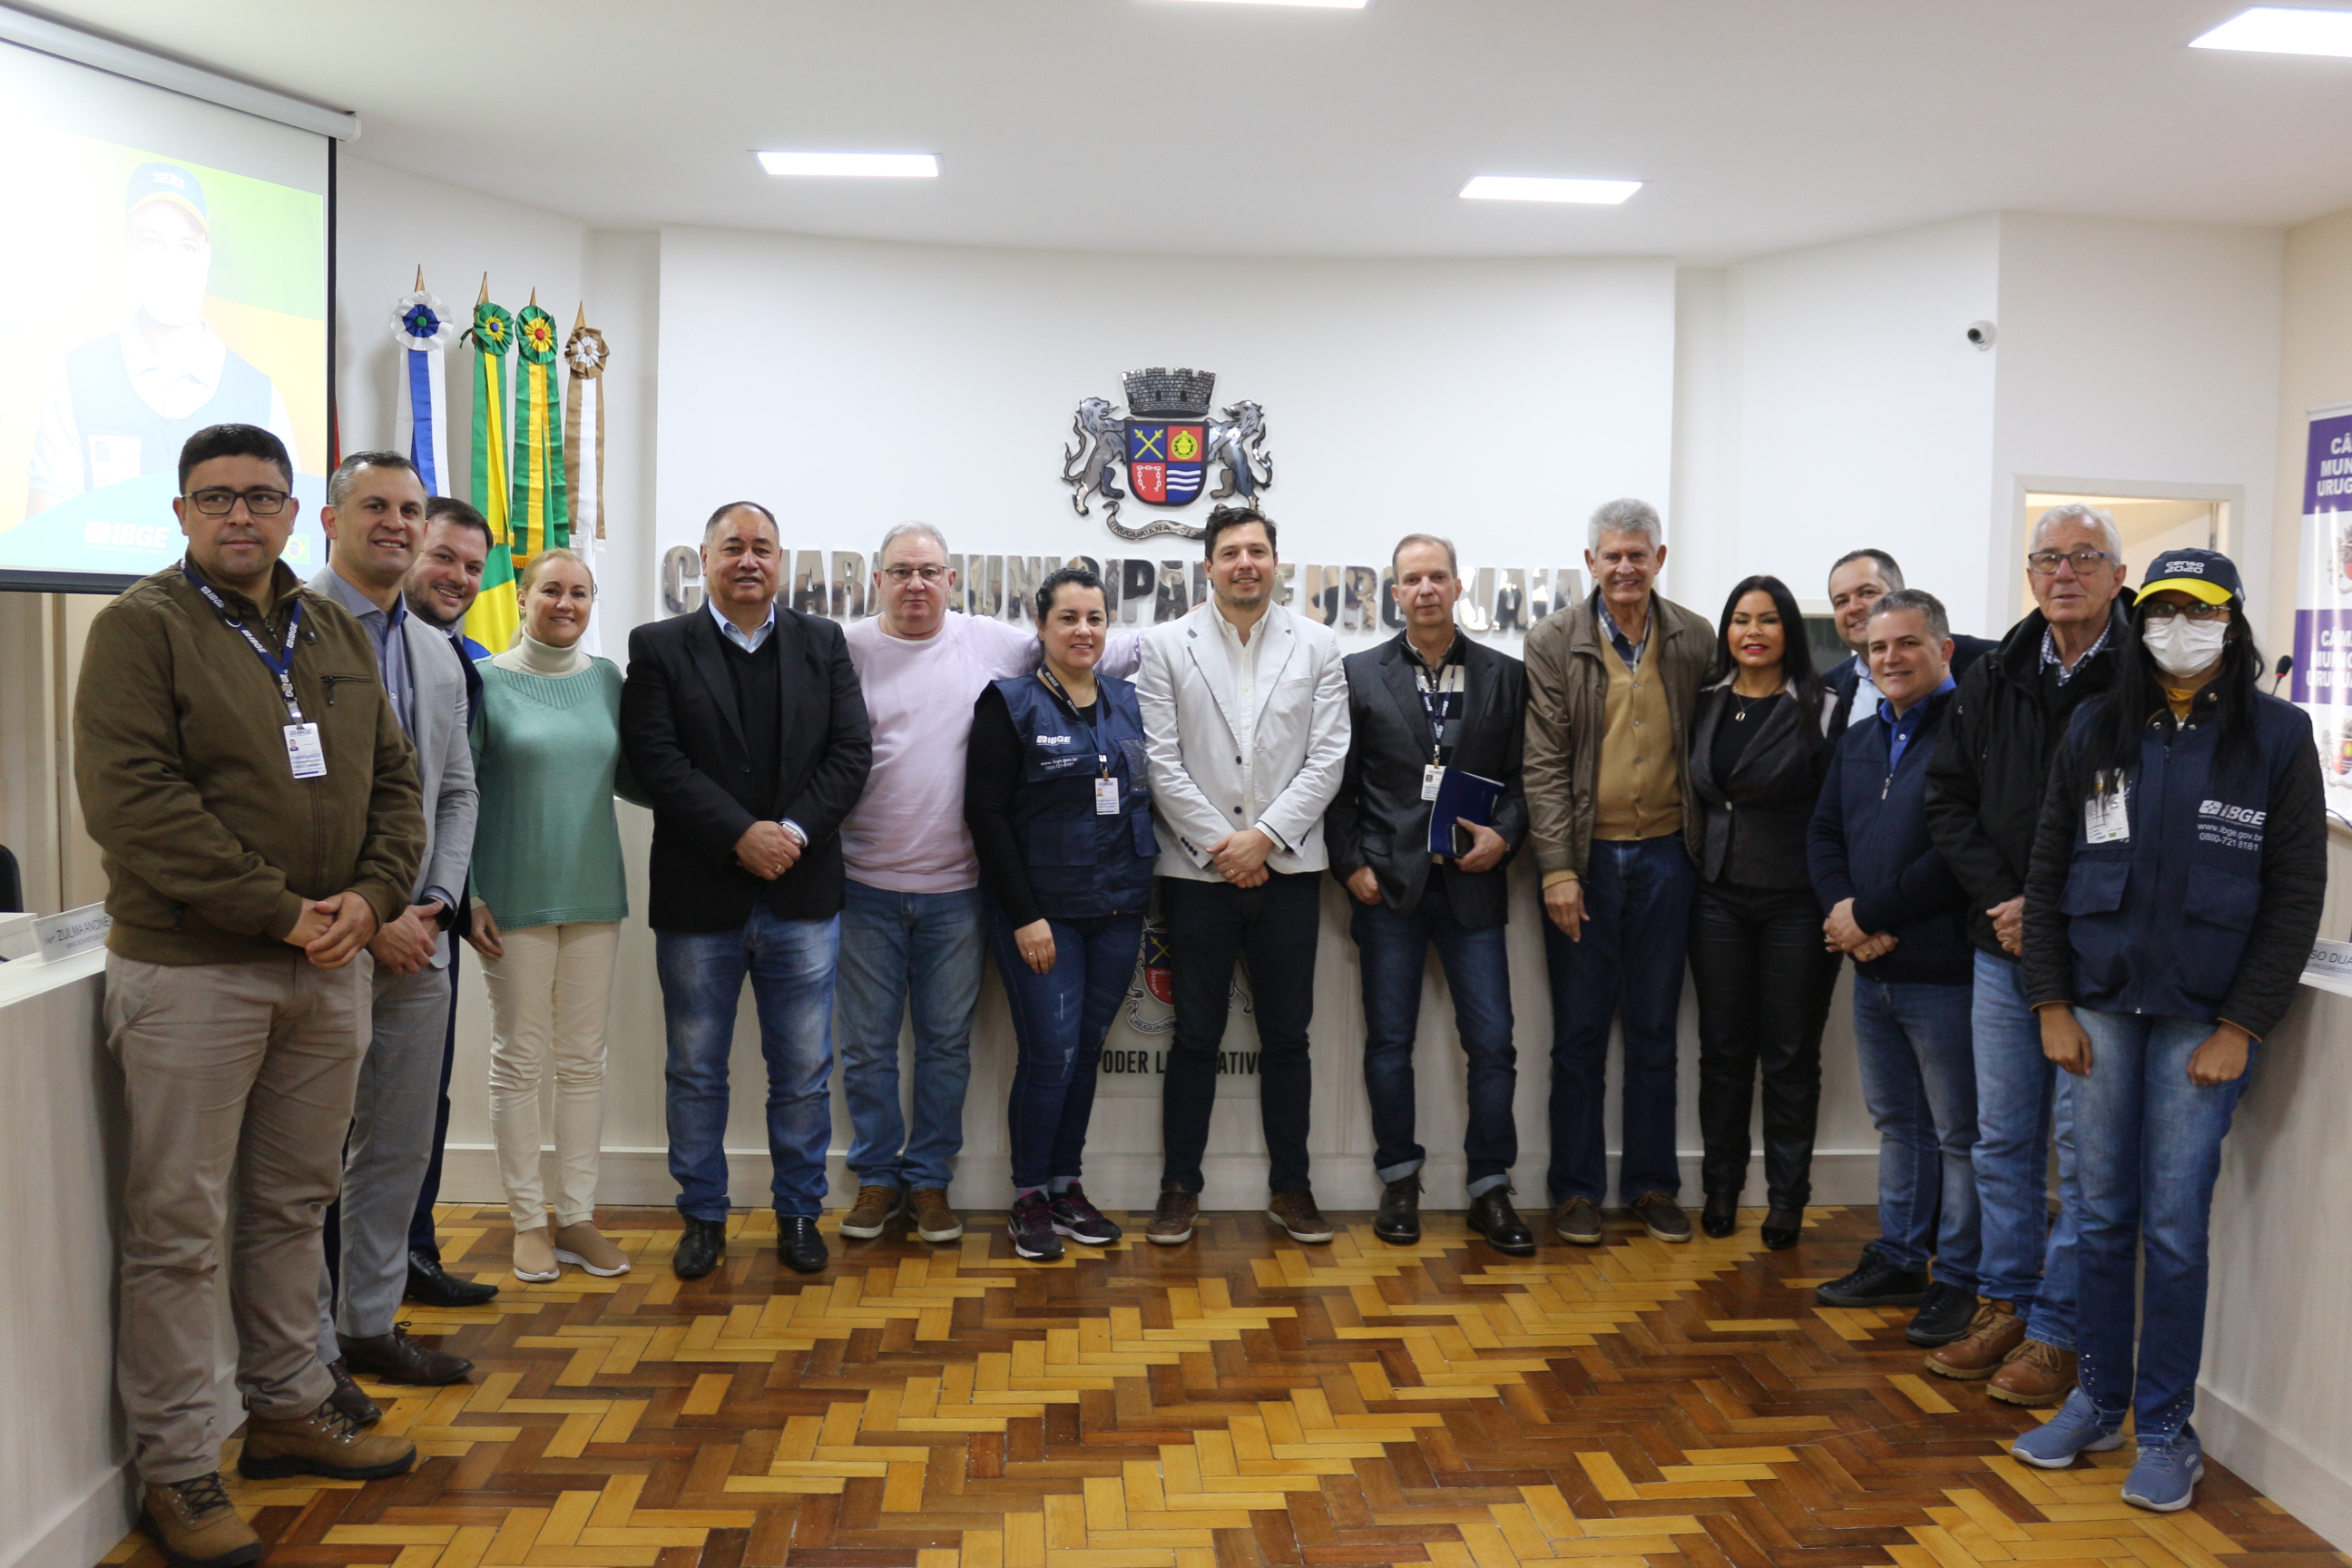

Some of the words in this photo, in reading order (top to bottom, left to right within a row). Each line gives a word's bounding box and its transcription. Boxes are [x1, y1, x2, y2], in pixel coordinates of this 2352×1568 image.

[111, 523, 171, 549] IBGE
[1108, 520, 1171, 540] URUGUAIANA
[2164, 565, 2204, 573] 2020
[207, 593, 225, 609] IBGE
[287, 622, 299, 640] IBGE
[248, 635, 268, 653] IBGE
[1047, 735, 1072, 744] IBGE
[2220, 804, 2267, 826] IBGE
[2197, 824, 2263, 842] www.ibge.gov.br
